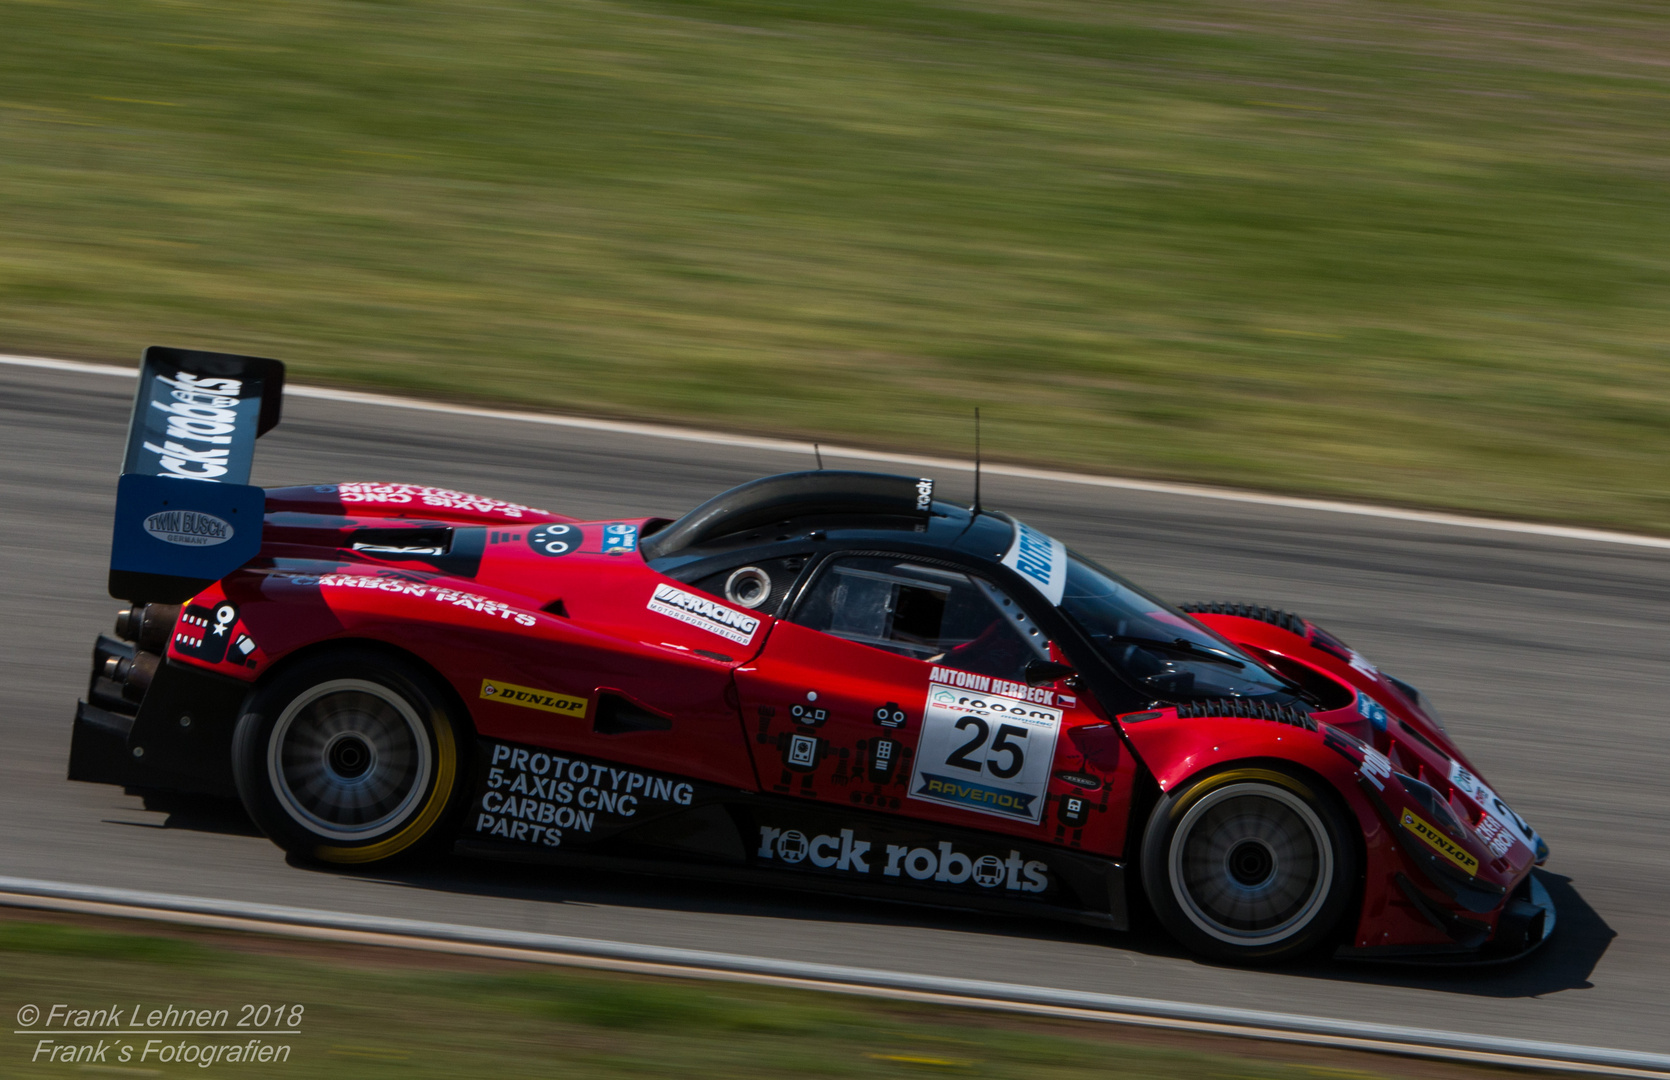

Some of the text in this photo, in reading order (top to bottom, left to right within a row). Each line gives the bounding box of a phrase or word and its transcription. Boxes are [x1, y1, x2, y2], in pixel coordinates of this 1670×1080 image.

[151, 371, 243, 444] robots
[339, 492, 412, 503] CNC
[148, 512, 226, 536] TWIN BUSCH
[167, 534, 208, 544] GERMANY
[291, 576, 537, 627] CARBON PARTS
[499, 688, 583, 711] DUNLOP
[929, 666, 1054, 705] ANTONIN HERBECK
[958, 697, 1055, 721] rooom
[945, 715, 1029, 779] 25
[487, 767, 638, 816] 5-AXIS CNC
[491, 744, 694, 805] PROTOTYPING
[482, 791, 595, 832] CARBON
[928, 780, 1025, 810] RAVENOL
[476, 813, 562, 847] PARTS
[1415, 823, 1476, 866] DUNLOP
[757, 825, 1048, 893] rock robots
